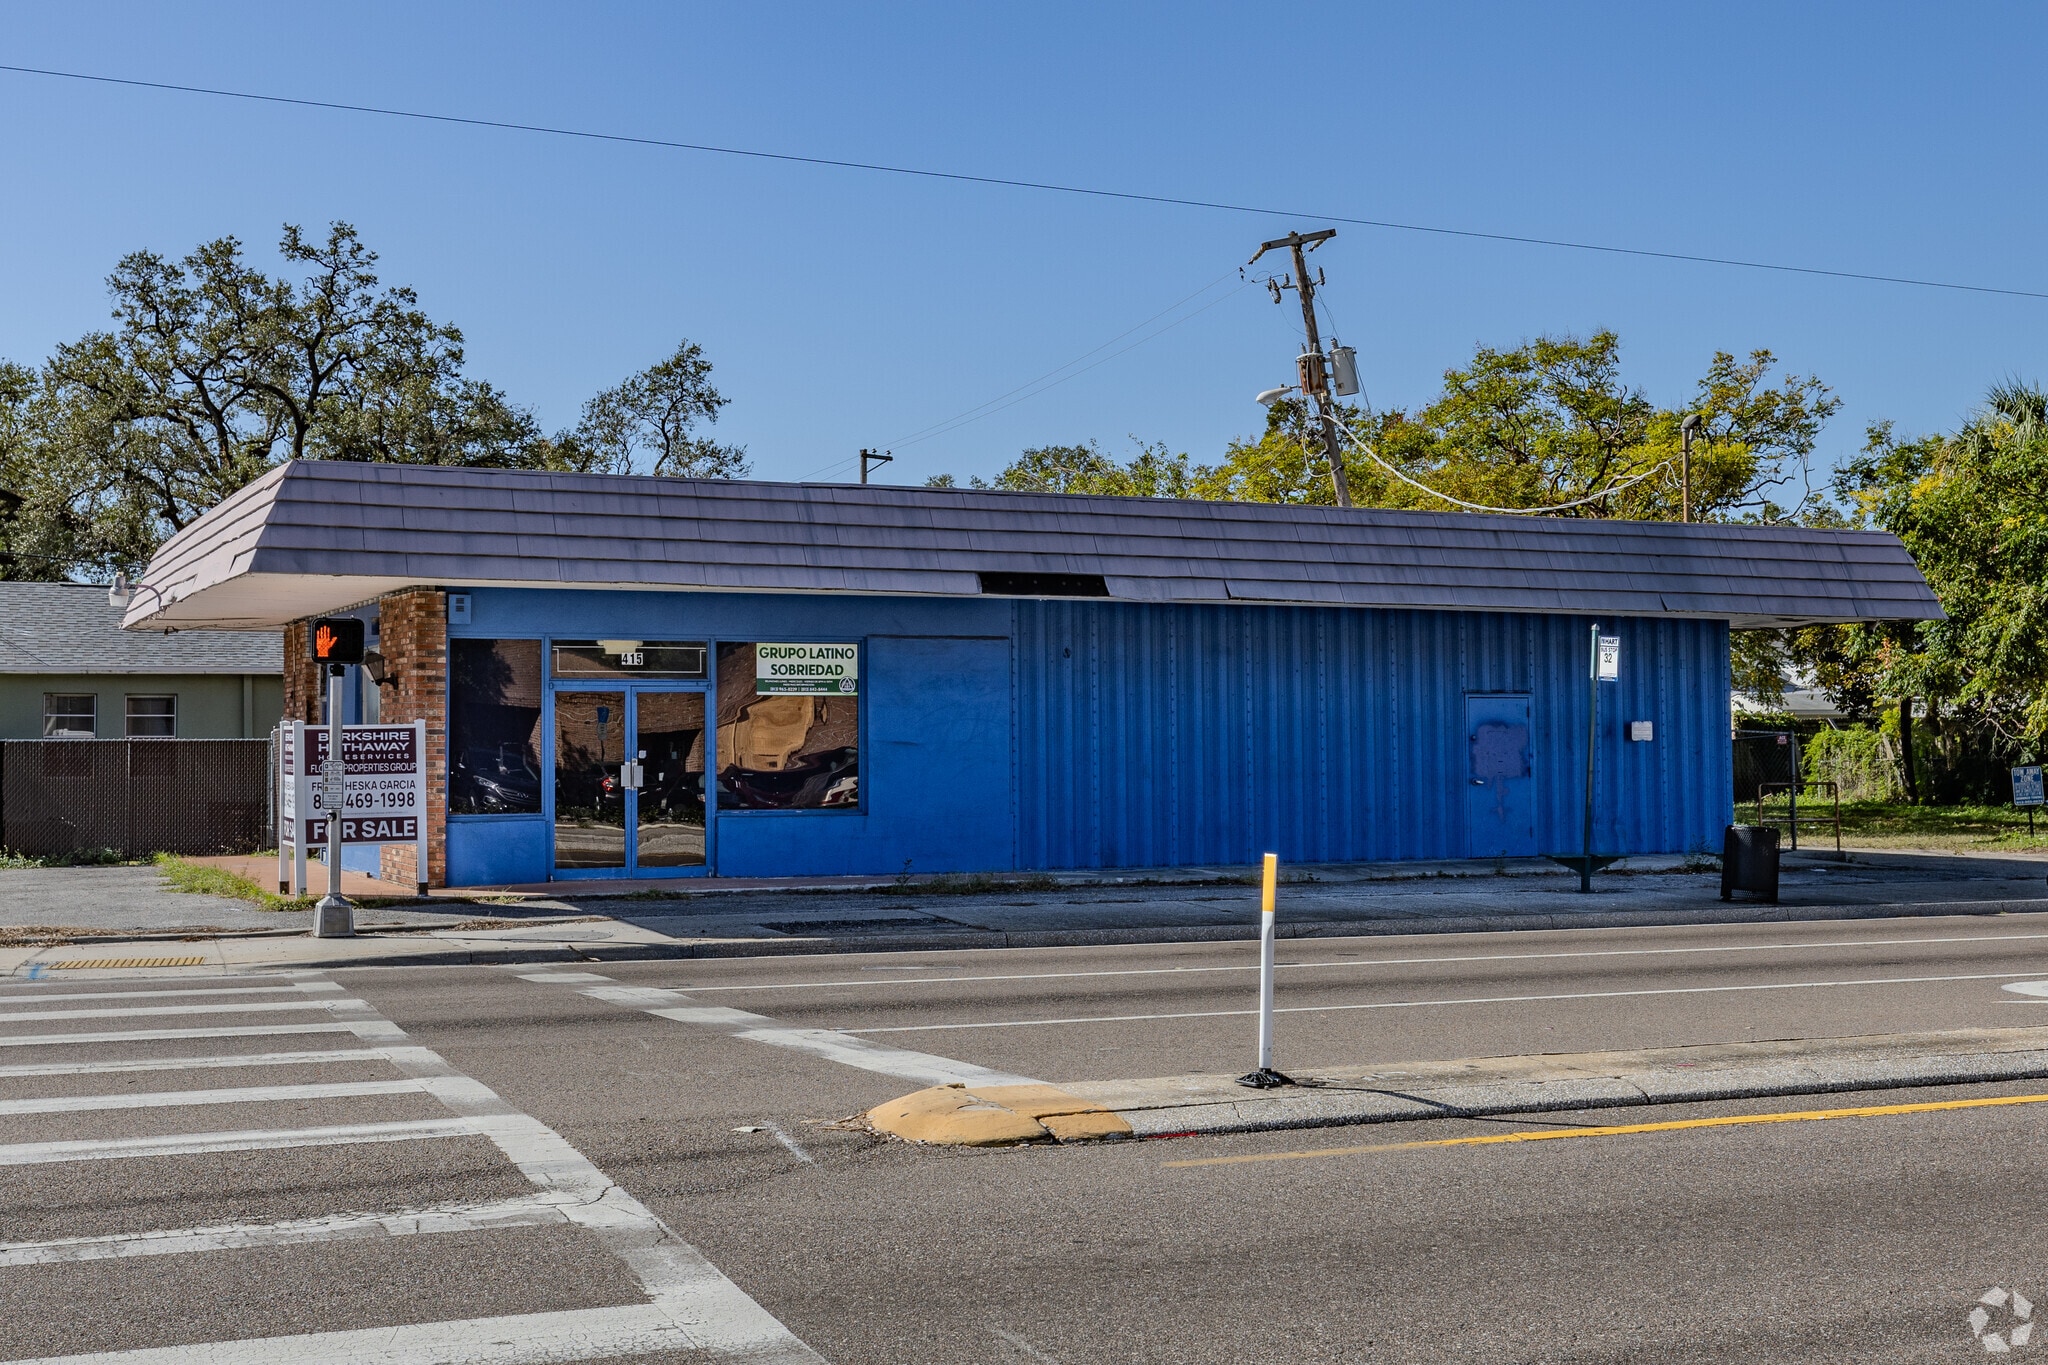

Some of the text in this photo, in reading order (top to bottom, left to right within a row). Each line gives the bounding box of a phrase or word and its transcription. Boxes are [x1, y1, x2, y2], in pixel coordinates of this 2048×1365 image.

[759, 646, 855, 660] GRUPO LATINO
[1604, 653, 1612, 664] 32
[622, 654, 641, 664] 415
[771, 664, 844, 676] SOBRIEDAD
[318, 731, 410, 742] BRKSHIRE
[318, 742, 410, 752] HTHAWAY
[344, 763, 389, 772] PROPERTIES
[390, 762, 417, 771] GROUP
[379, 780, 416, 790] GARCIA
[313, 821, 356, 839] FR
[361, 819, 416, 839] SALE
